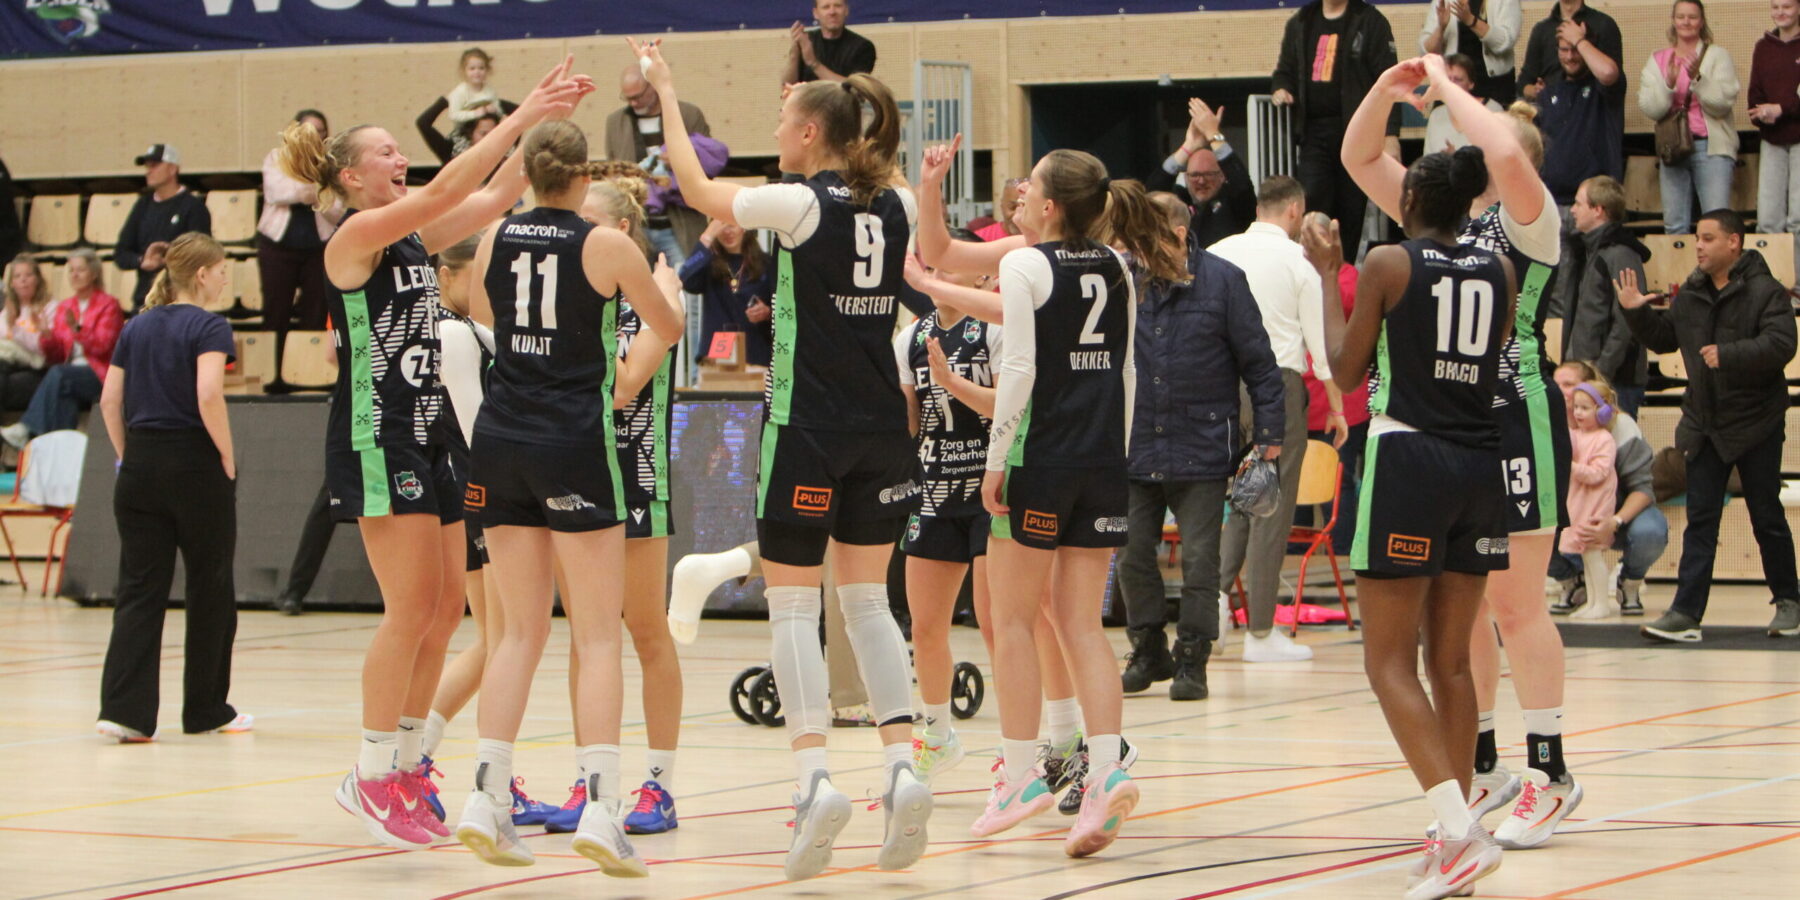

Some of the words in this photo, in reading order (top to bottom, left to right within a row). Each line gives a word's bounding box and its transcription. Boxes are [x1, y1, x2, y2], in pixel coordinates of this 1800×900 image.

[504, 223, 558, 238] macron
[852, 211, 886, 289] 9
[510, 251, 559, 330] 11
[828, 293, 895, 316] KERSTEDT
[1079, 273, 1108, 345] 2
[1431, 275, 1494, 357] 10
[511, 333, 552, 356] KUIJT
[1069, 350, 1112, 371] DEKKER
[940, 439, 964, 452] Zorg
[966, 438, 981, 447] en
[799, 492, 828, 505] PLUS
[1028, 516, 1056, 530] PLUS
[1393, 541, 1425, 554] PLUS
